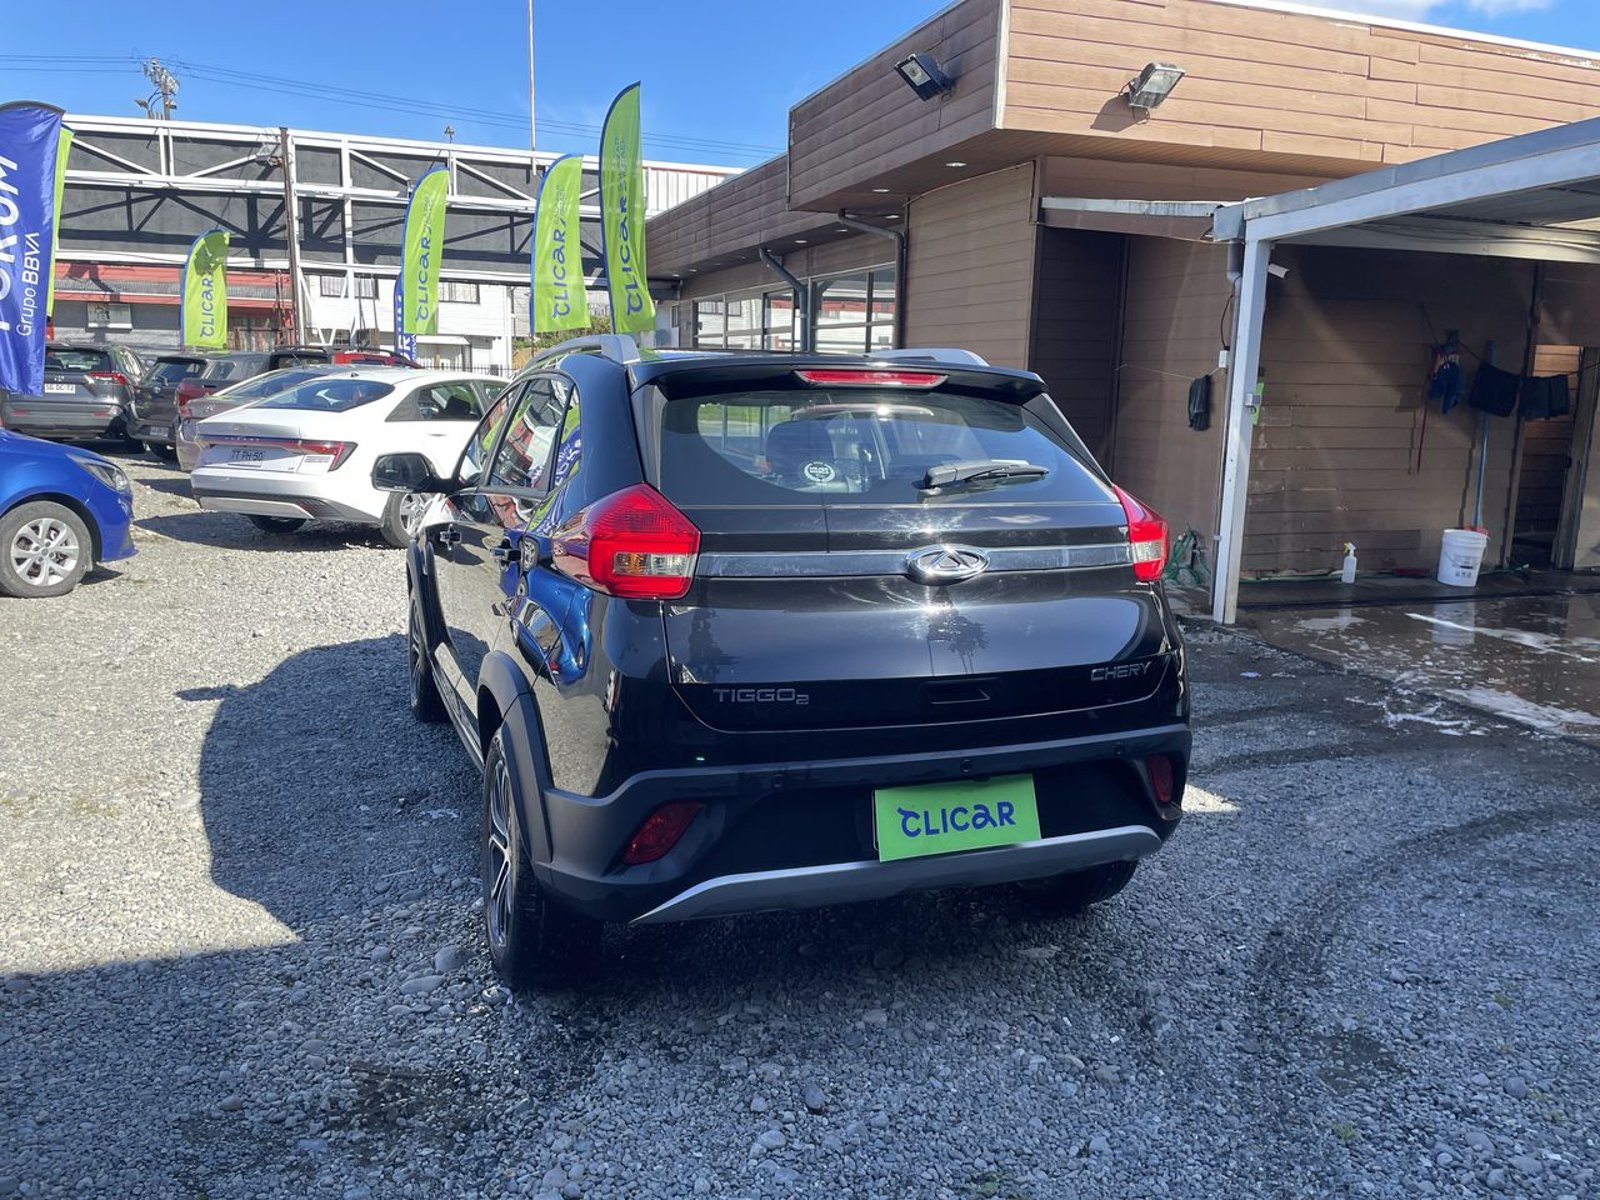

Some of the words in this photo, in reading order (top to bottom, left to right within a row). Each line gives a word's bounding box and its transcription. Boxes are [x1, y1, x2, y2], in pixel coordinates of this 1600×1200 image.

[22, 232, 40, 285] BBVA
[16, 287, 38, 337] Grupo
[1091, 661, 1152, 681] CHERY
